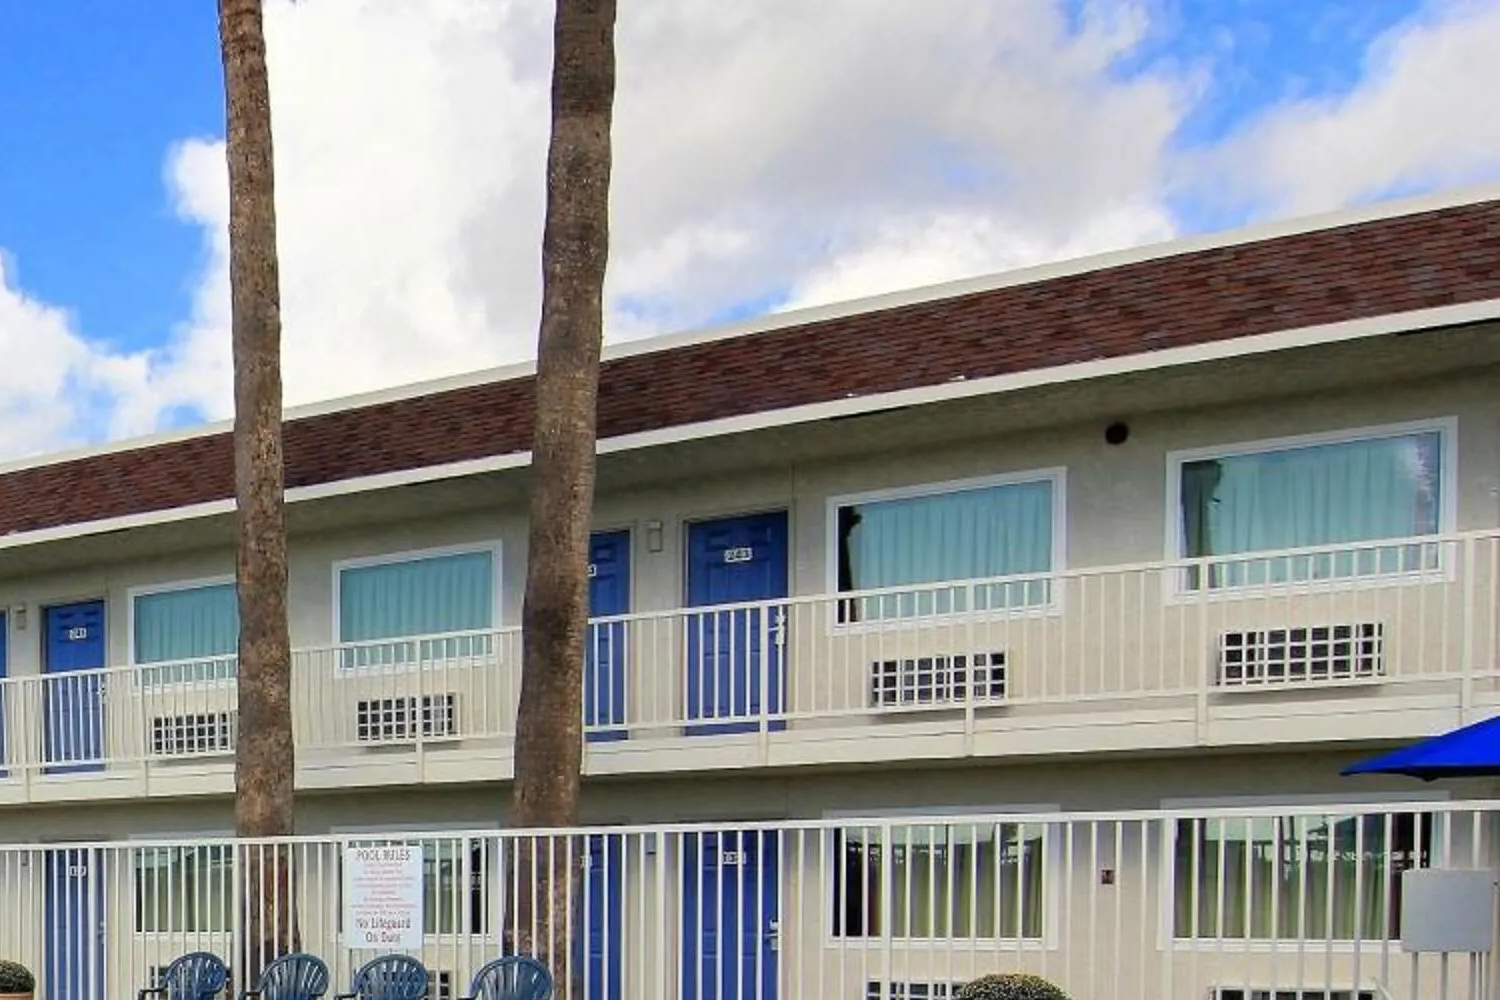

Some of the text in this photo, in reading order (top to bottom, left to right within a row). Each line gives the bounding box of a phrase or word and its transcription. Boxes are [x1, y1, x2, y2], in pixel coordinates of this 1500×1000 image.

[356, 849, 412, 861] POOL RULES
[371, 917, 412, 931] Lifeguard
